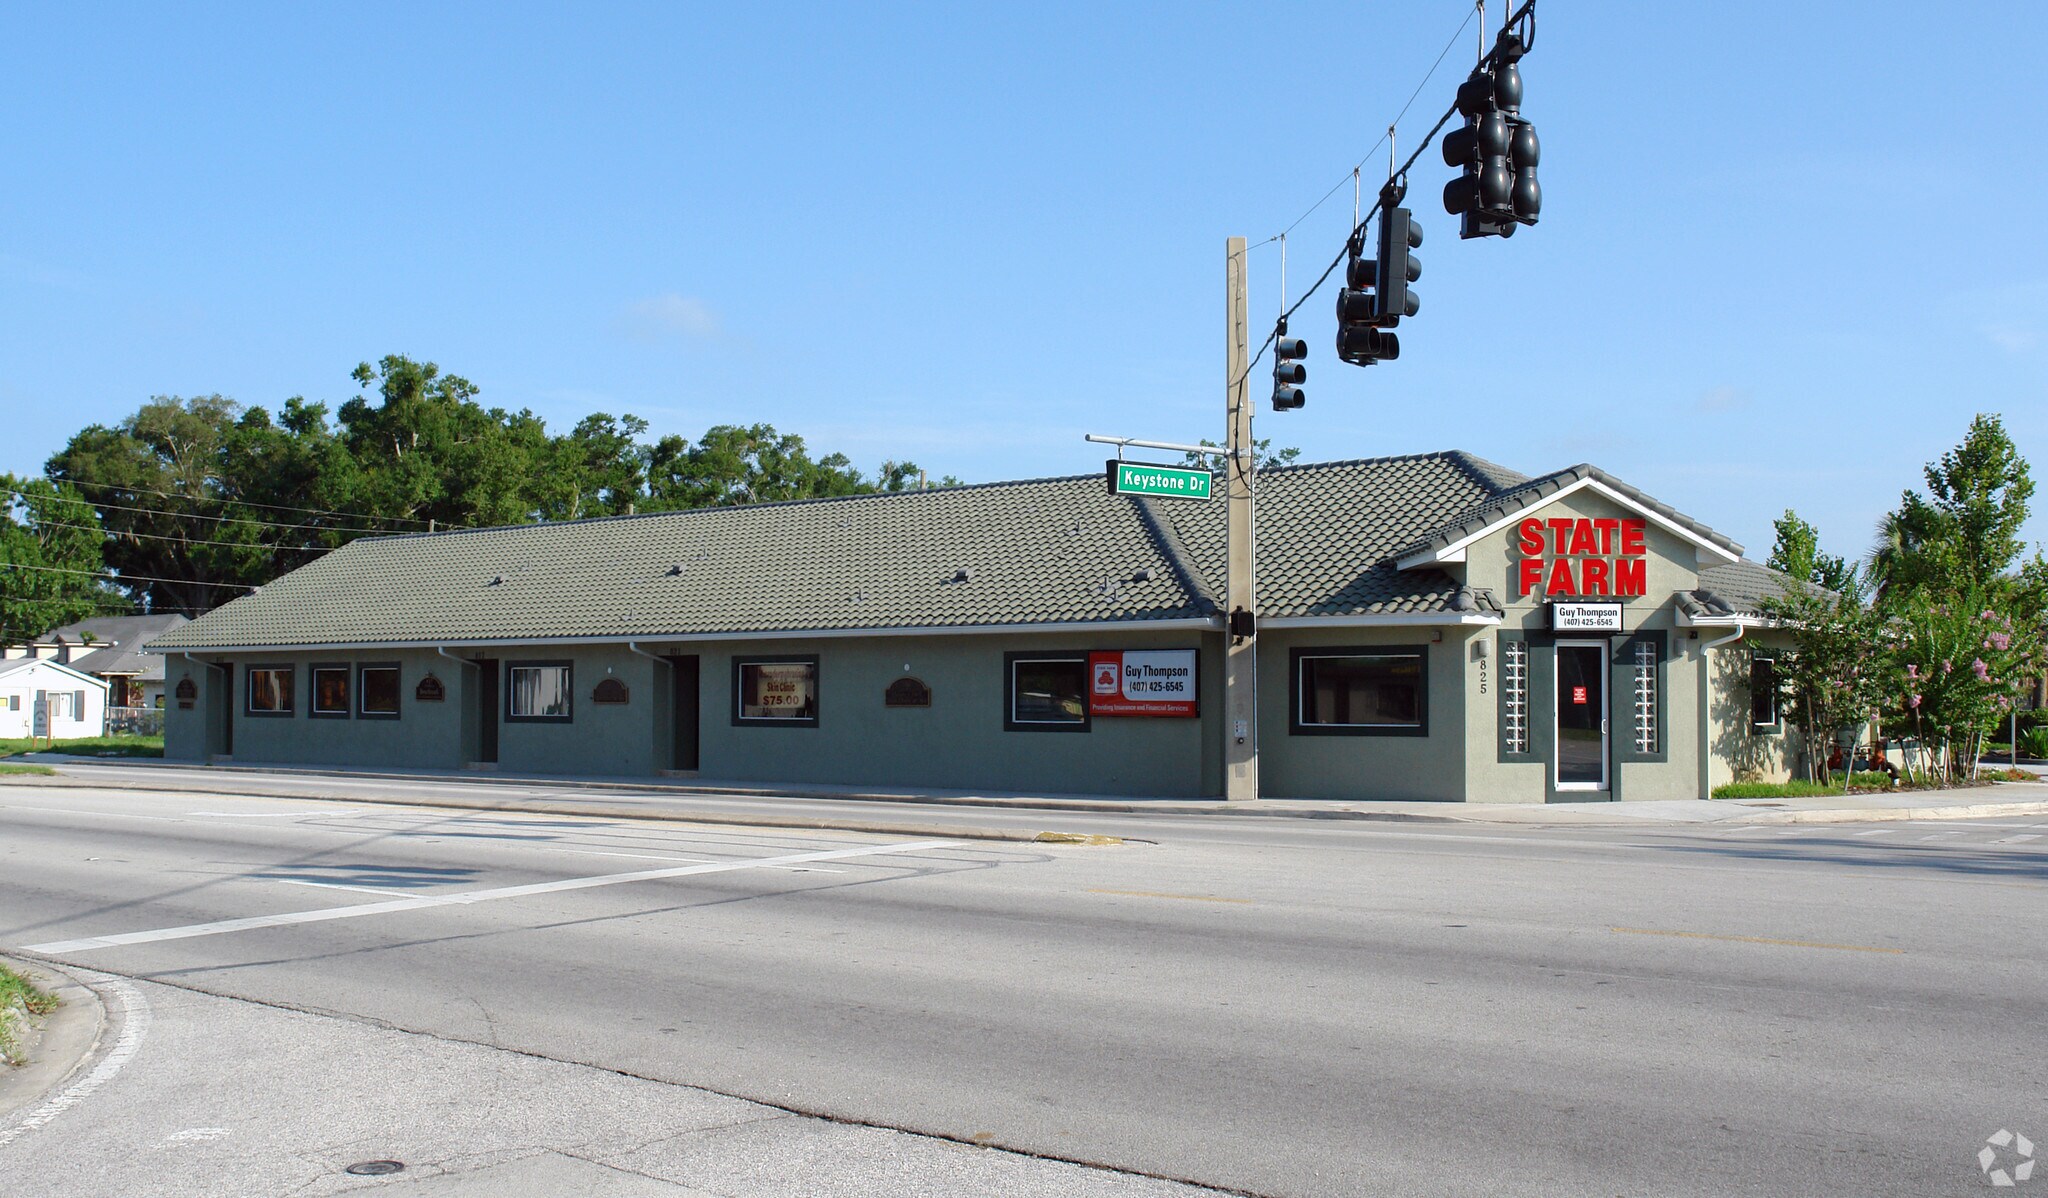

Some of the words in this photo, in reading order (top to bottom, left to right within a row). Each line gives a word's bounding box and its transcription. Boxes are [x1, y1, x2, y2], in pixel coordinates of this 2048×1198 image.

[1124, 470, 1185, 490] Keystone
[1189, 476, 1205, 491] Dr
[1518, 517, 1647, 556] STATE
[1518, 558, 1647, 597] FARM
[1559, 607, 1576, 618] Guy
[1576, 607, 1618, 618] Thompson
[1563, 618, 1581, 627] (407)
[1581, 618, 1613, 626] 425-6545
[1125, 664, 1142, 679] Guy
[1143, 664, 1188, 679] Thompson
[1129, 681, 1148, 693] (407)
[1149, 681, 1184, 692] 425-6545
[763, 694, 799, 706] $75.00
[1167, 704, 1189, 712] Services
